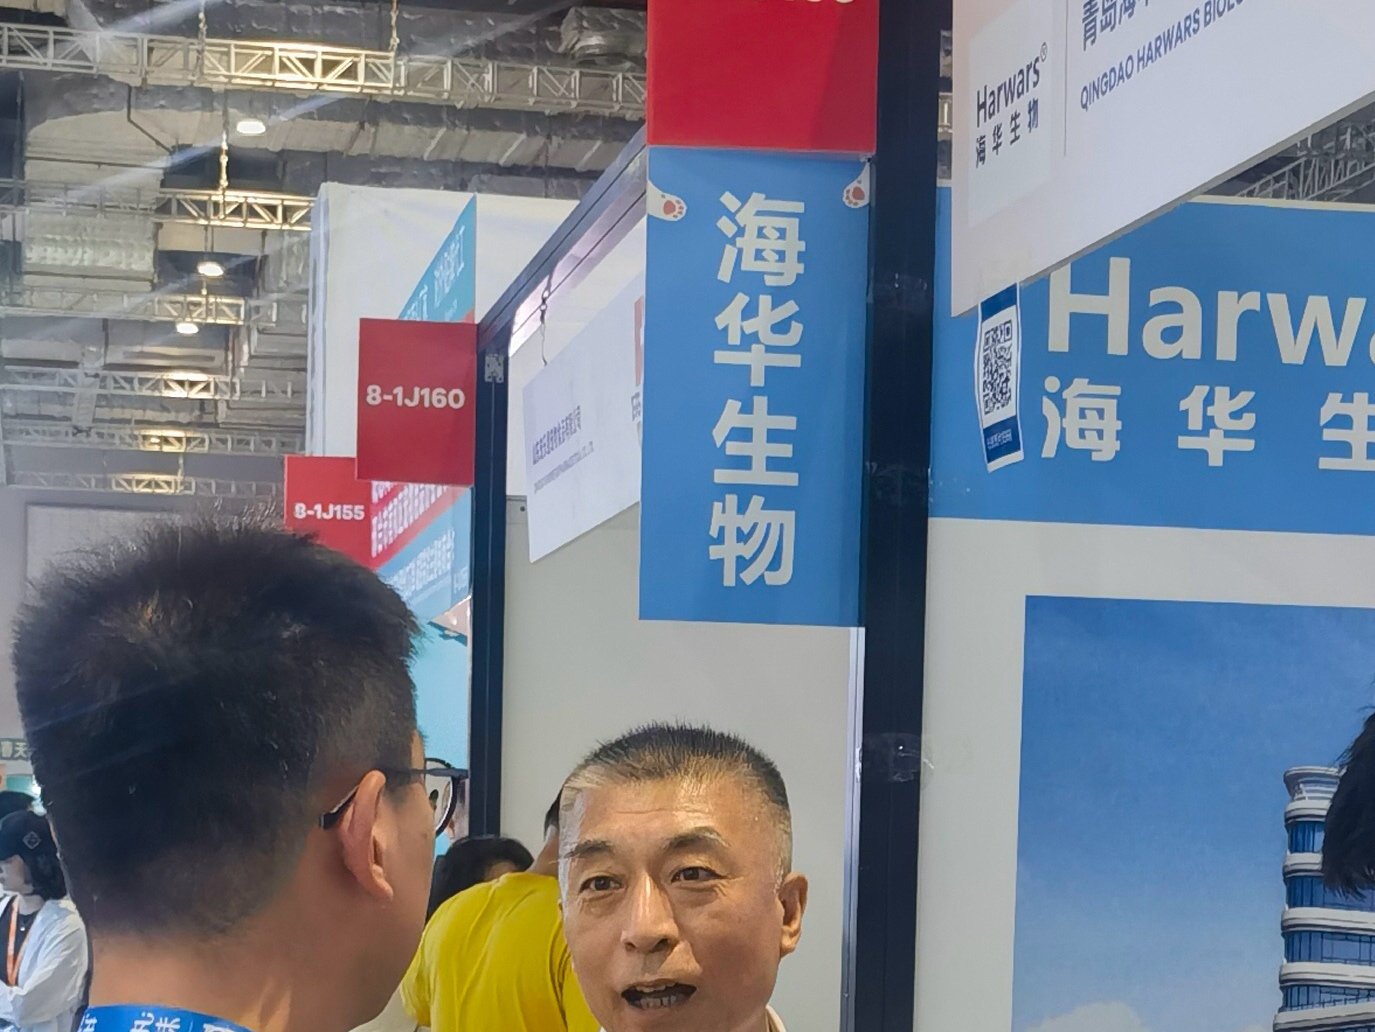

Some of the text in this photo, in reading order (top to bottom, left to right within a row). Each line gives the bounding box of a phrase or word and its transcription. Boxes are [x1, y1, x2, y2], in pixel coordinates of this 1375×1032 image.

[1080, 55, 1135, 112] QINGDAO
[1137, 8, 1201, 74] HARWARS
[975, 97, 1040, 168] 海华生物
[1047, 256, 1375, 367] Harw
[366, 385, 466, 410] 8-1J160
[709, 191, 806, 588] 海华生物
[293, 502, 365, 521] 8-1J155
